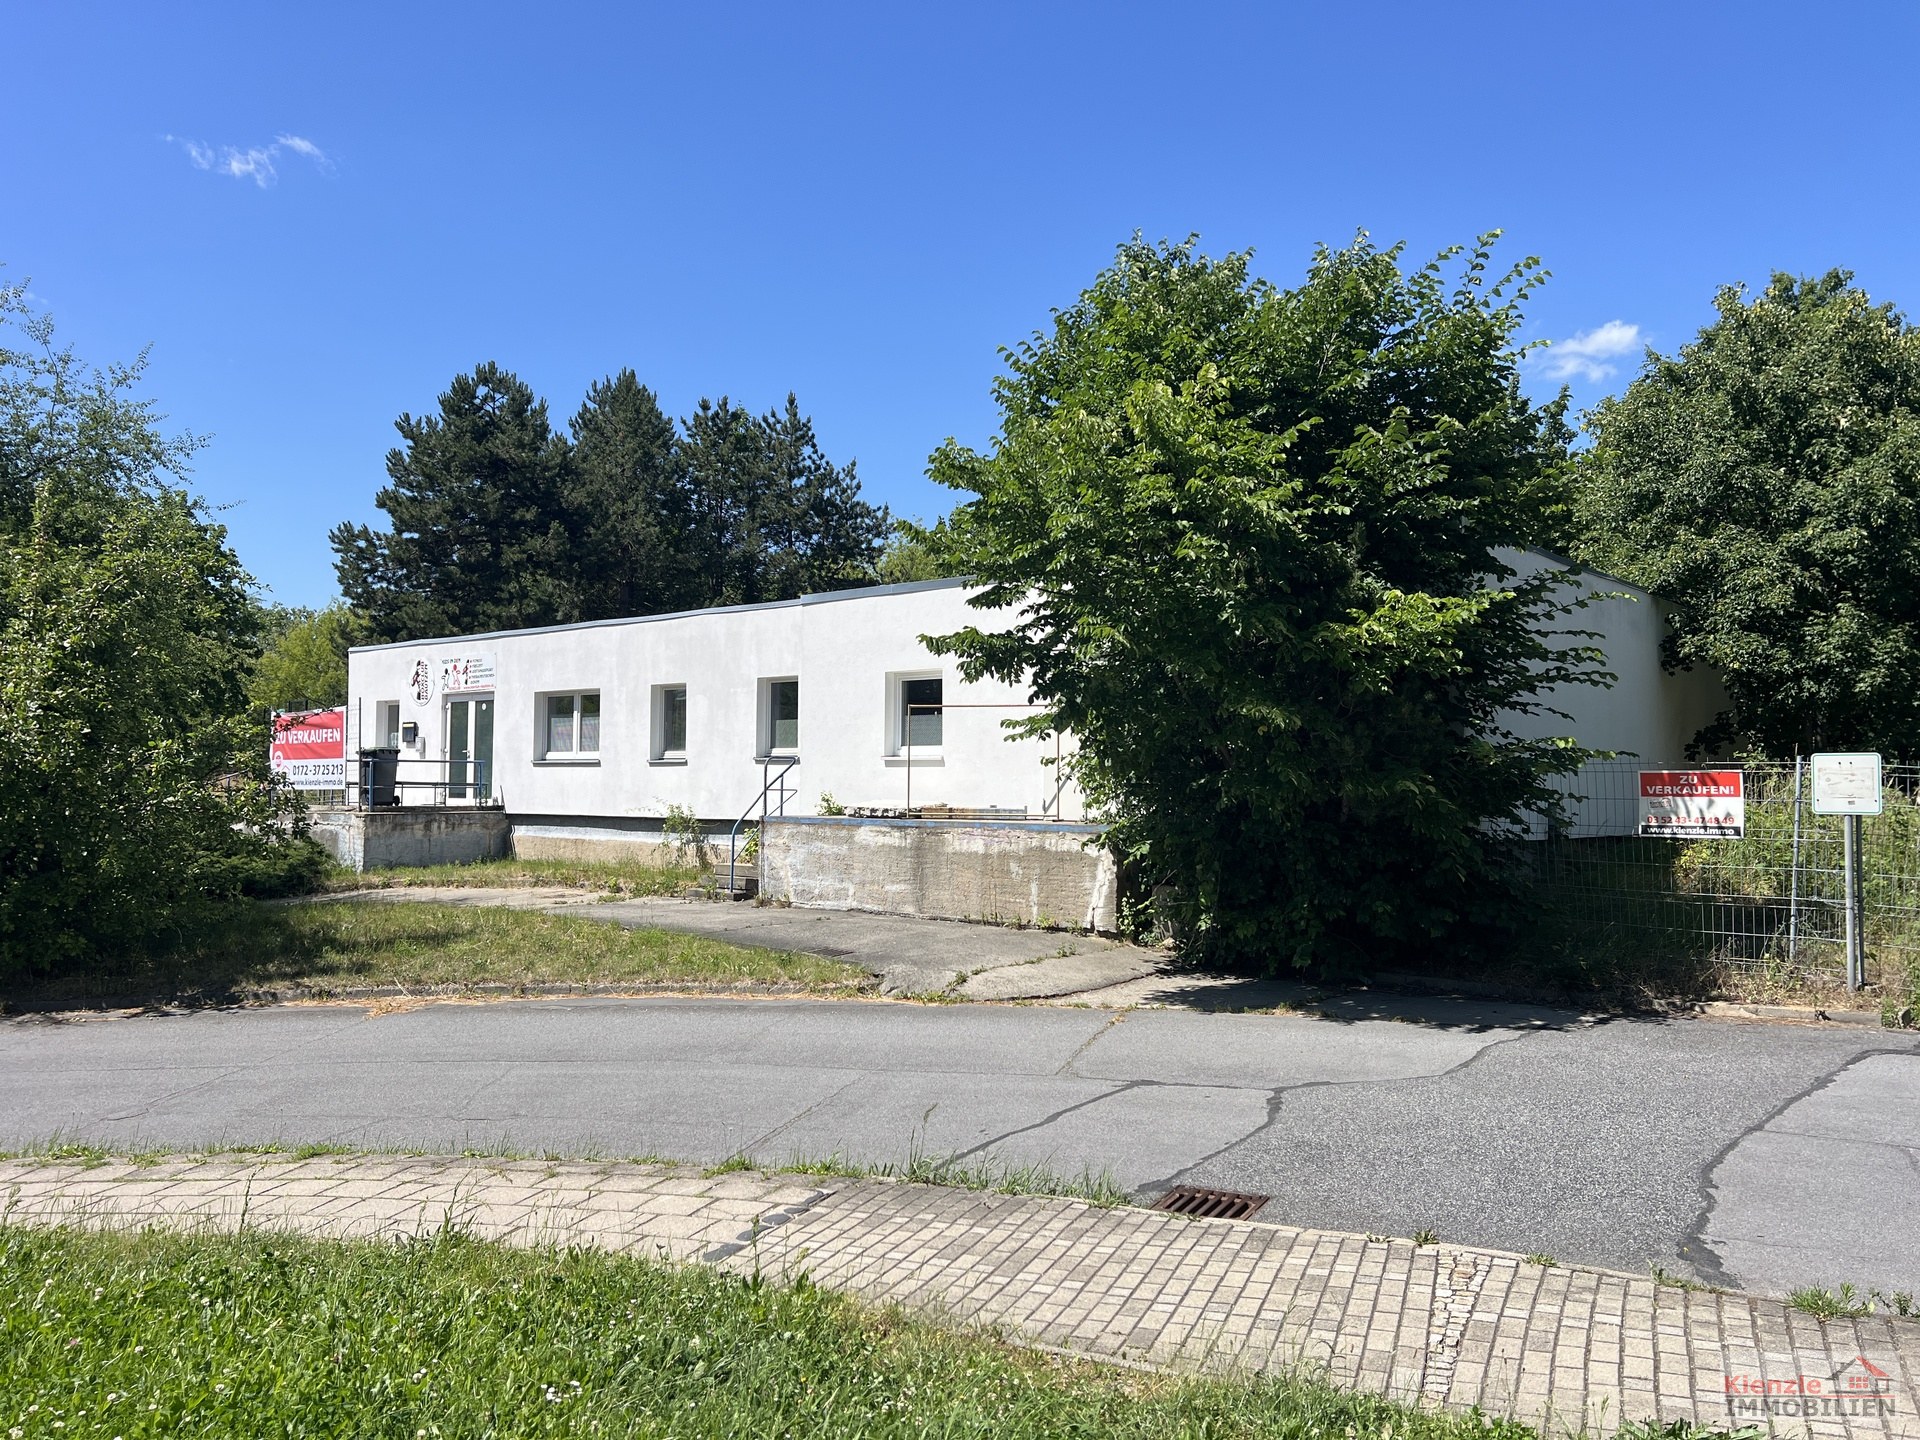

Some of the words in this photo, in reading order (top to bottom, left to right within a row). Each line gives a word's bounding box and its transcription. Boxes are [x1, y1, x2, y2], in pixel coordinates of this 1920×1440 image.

[275, 730, 286, 744] ZU
[288, 728, 340, 744] VERKAUFEN
[293, 765, 308, 776] 0172
[313, 765, 320, 775] 37
[322, 764, 330, 775] 25
[331, 764, 343, 775] 213
[1680, 775, 1698, 784] ZU
[1646, 785, 1734, 795] VERKAUFEN!
[1647, 816, 1659, 824] 03
[1661, 816, 1672, 824] 52
[1647, 827, 1735, 835] www.kienzle.immo
